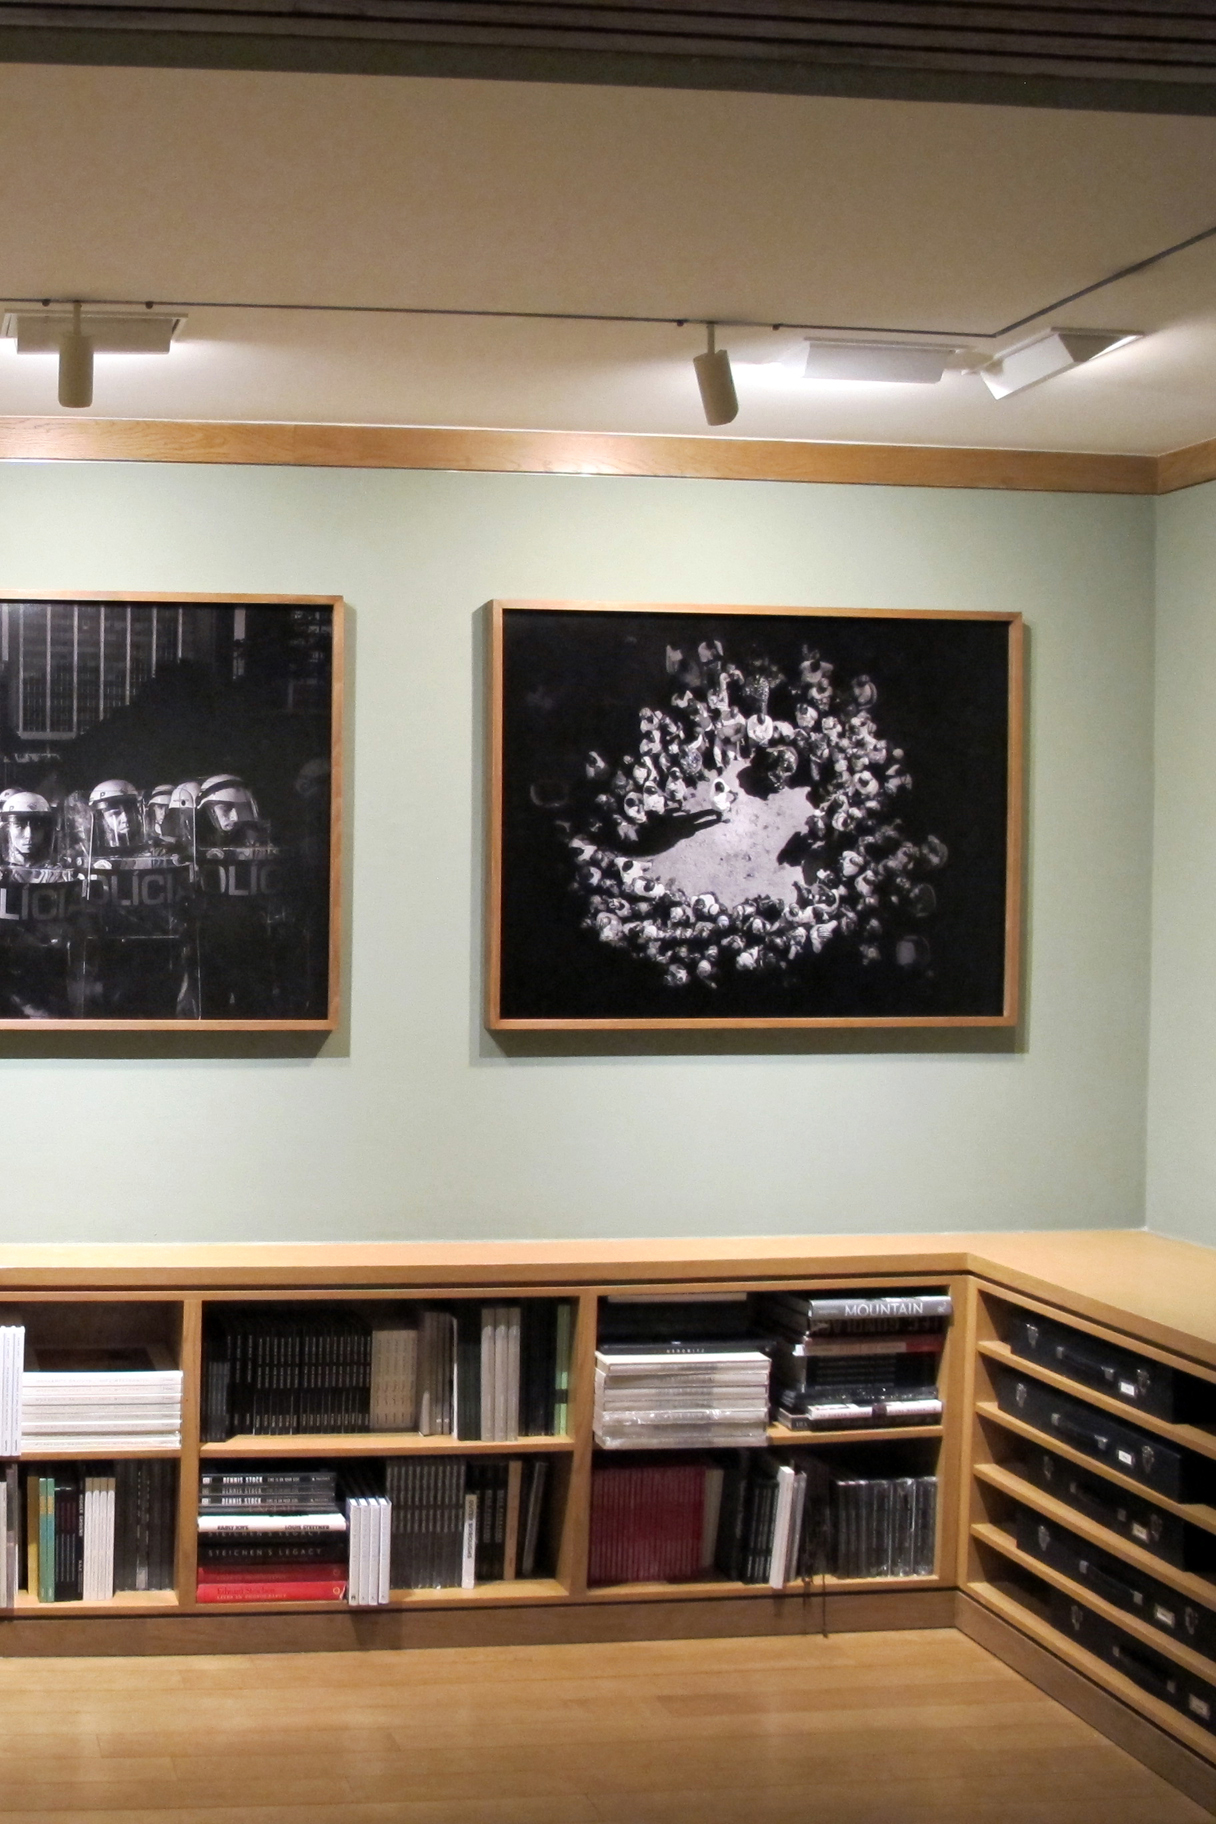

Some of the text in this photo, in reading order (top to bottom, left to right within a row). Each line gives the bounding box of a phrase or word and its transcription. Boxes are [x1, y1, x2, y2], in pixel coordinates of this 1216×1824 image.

[844, 1302, 924, 1317] MOUNTAIN
[222, 1476, 244, 1484] DENNIS
[245, 1476, 263, 1484] STOCK
[221, 1497, 242, 1505] DENNIS
[244, 1497, 262, 1505] STOCK
[278, 1548, 322, 1556] LEGACY
